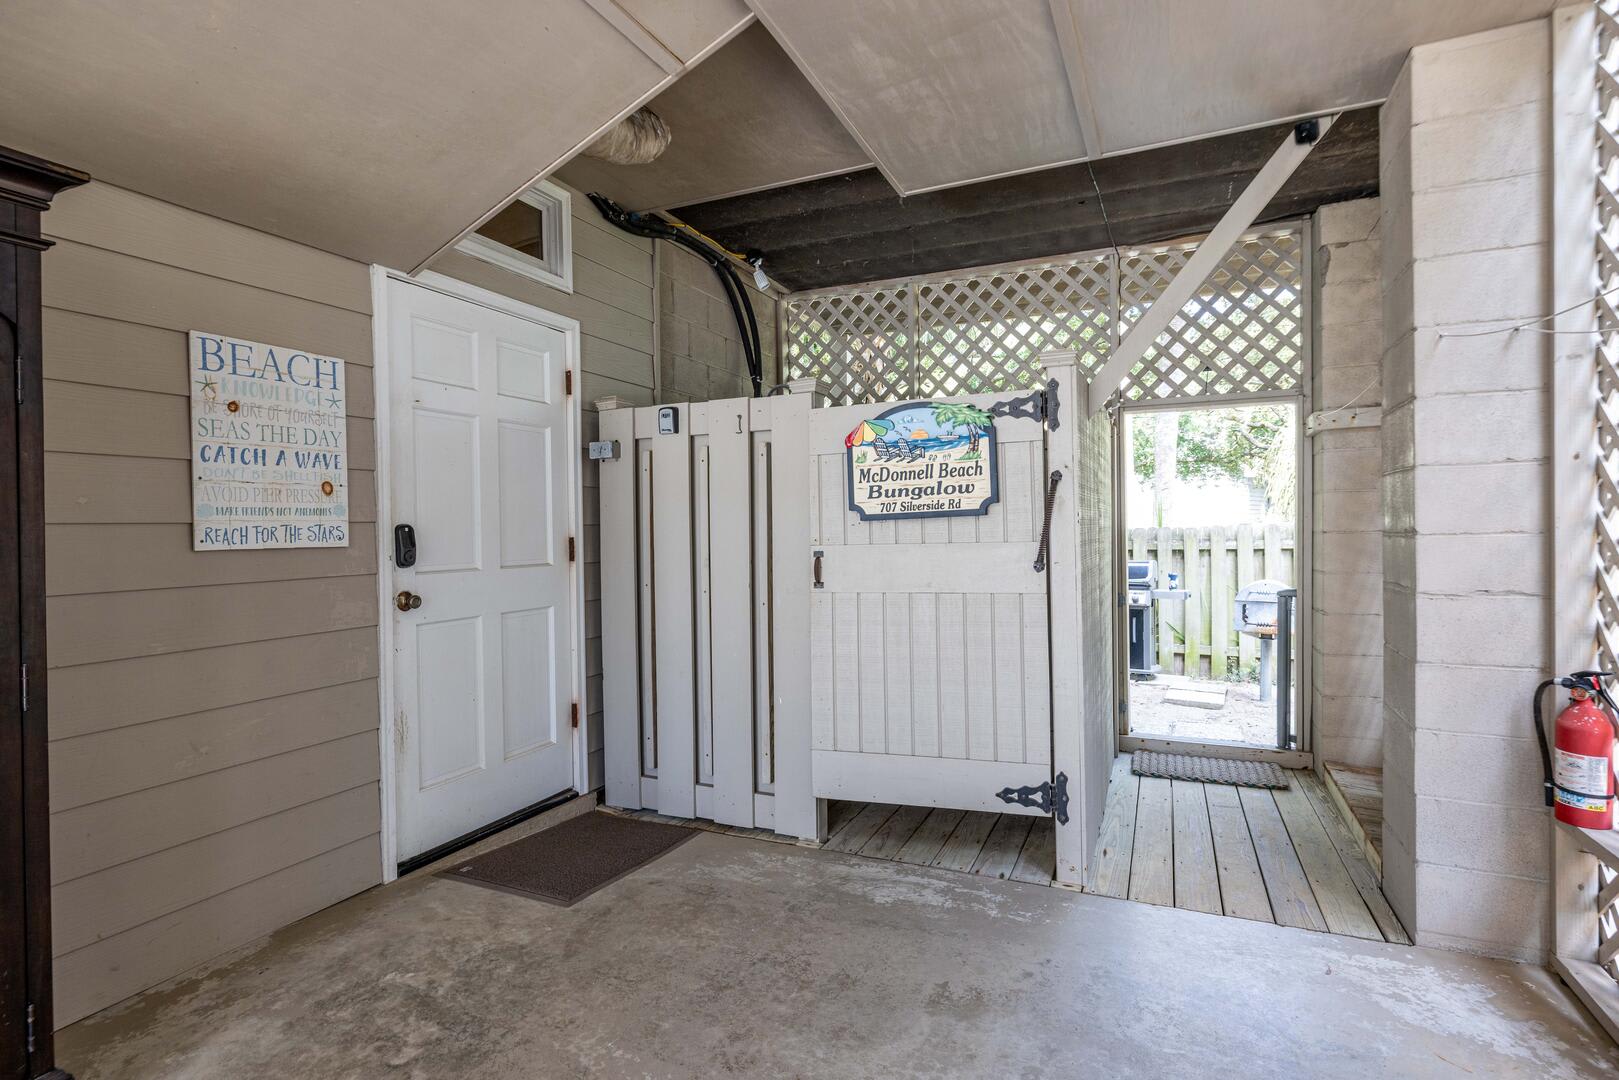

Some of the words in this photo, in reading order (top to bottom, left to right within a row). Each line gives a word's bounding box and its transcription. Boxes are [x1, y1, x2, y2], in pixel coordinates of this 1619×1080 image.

[196, 336, 340, 390] BEACH
[220, 377, 322, 408] KNOWLEDGE
[267, 405, 281, 423] OF
[285, 408, 338, 428] YOURSELF
[198, 417, 251, 440] SEAS
[255, 424, 298, 444] THE
[303, 427, 342, 448] DAY
[200, 445, 267, 467] CATCH
[275, 450, 287, 466] A
[295, 451, 342, 470] WAVE
[252, 470, 266, 480] BE
[858, 463, 934, 484] McDonnell
[938, 460, 983, 479] Beach
[202, 486, 249, 503] AVOID
[253, 488, 281, 504] PIER
[867, 481, 975, 500] Bungalow
[215, 506, 239, 517] MAKE
[241, 506, 274, 518] FRIENDS
[276, 507, 293, 517] NOT
[294, 507, 332, 517] ANEMONES
[880, 502, 897, 512] 707
[900, 500, 945, 512] Silverside
[948, 499, 961, 509] Rd
[204, 525, 248, 546] REACH
[252, 525, 279, 543] FOR
[280, 524, 303, 544] THE
[307, 523, 345, 543] STARS
